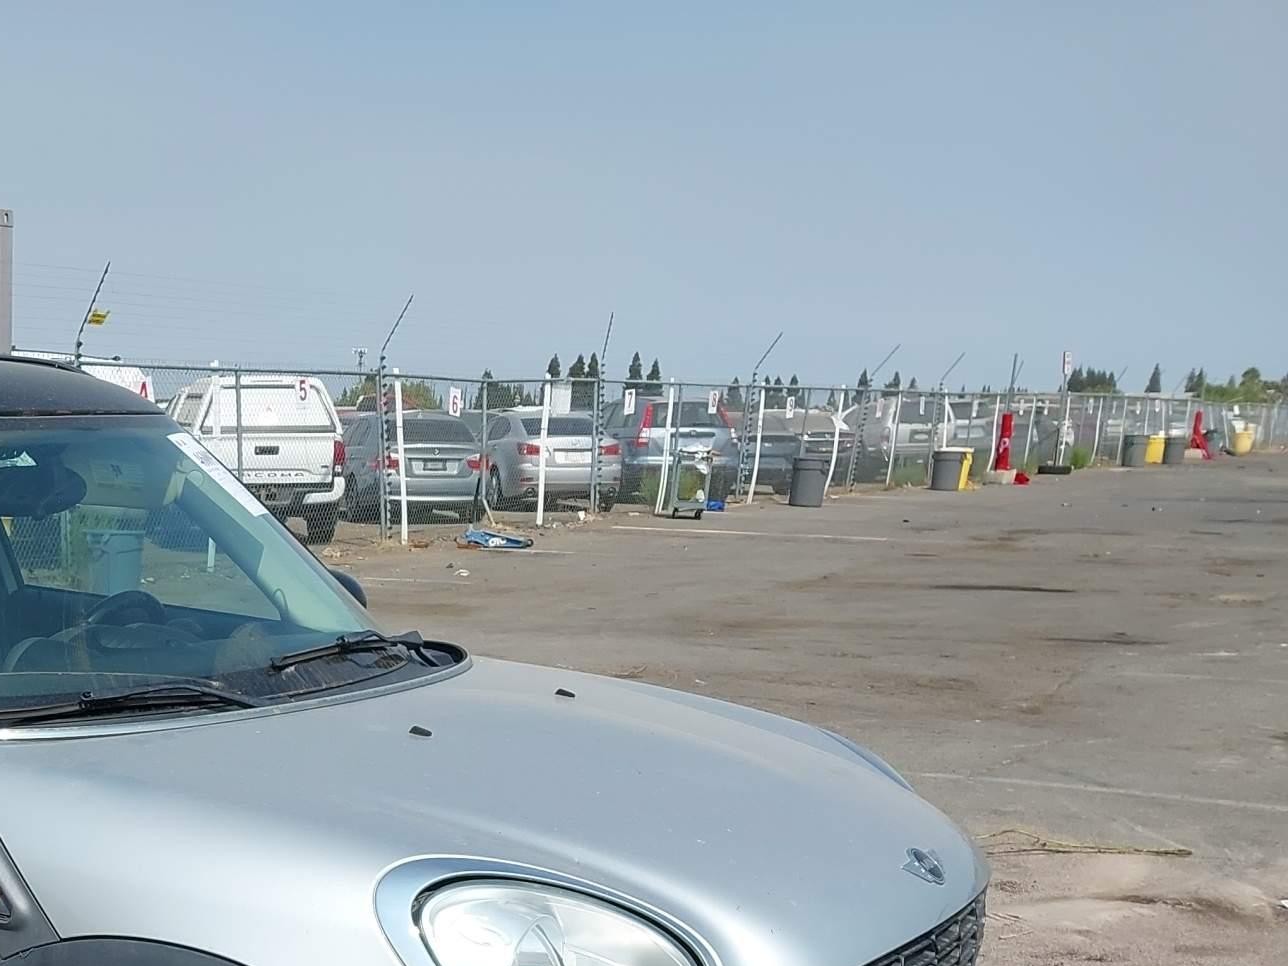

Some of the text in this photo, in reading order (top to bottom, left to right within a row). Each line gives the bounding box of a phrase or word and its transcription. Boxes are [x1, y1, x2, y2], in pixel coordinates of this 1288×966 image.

[299, 379, 308, 402] 5
[627, 391, 633, 409] 7
[711, 392, 717, 408] 8
[452, 394, 458, 414] 6
